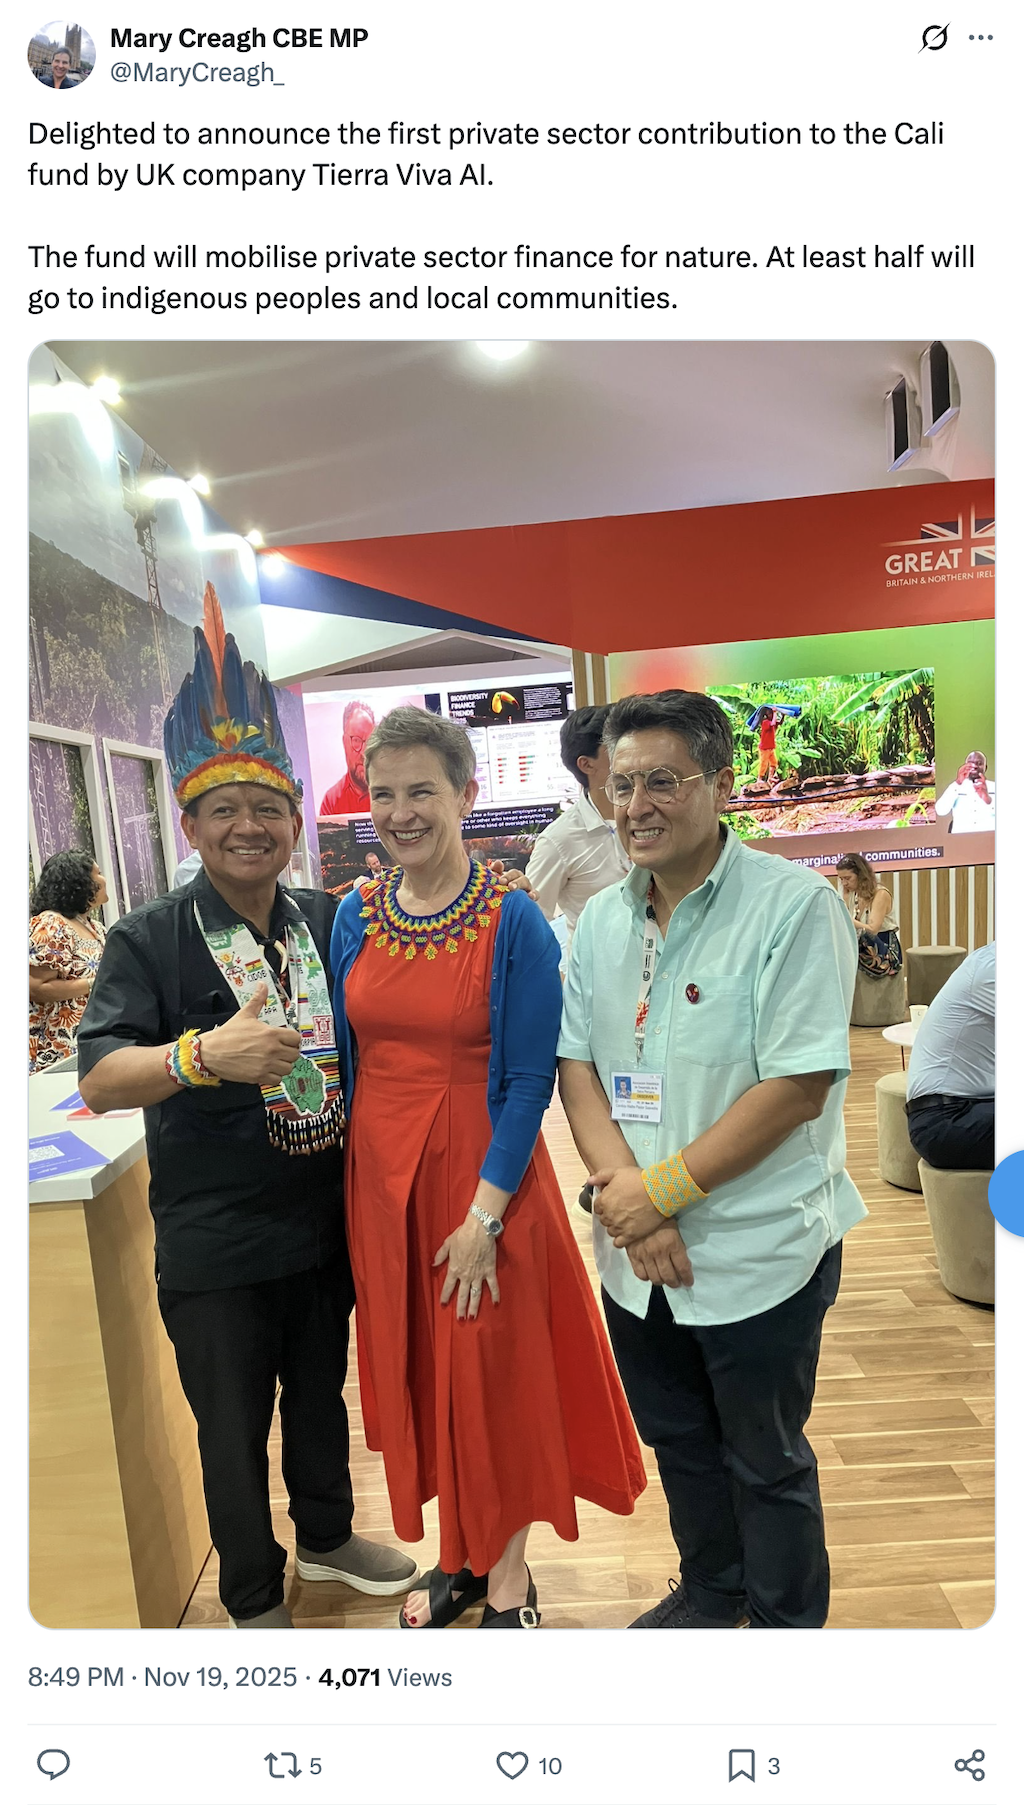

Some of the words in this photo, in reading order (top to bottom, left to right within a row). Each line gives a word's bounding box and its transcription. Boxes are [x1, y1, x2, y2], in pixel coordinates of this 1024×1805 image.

[885, 548, 963, 575] GREAT
[886, 577, 918, 588] BRITAIN
[920, 576, 927, 585] &
[928, 571, 974, 584] NORTHERN
[450, 693, 489, 702] BIODIVERSITY
[451, 702, 476, 710] FINANCE
[452, 709, 475, 717] TRENDS
[865, 847, 941, 862] communities.
